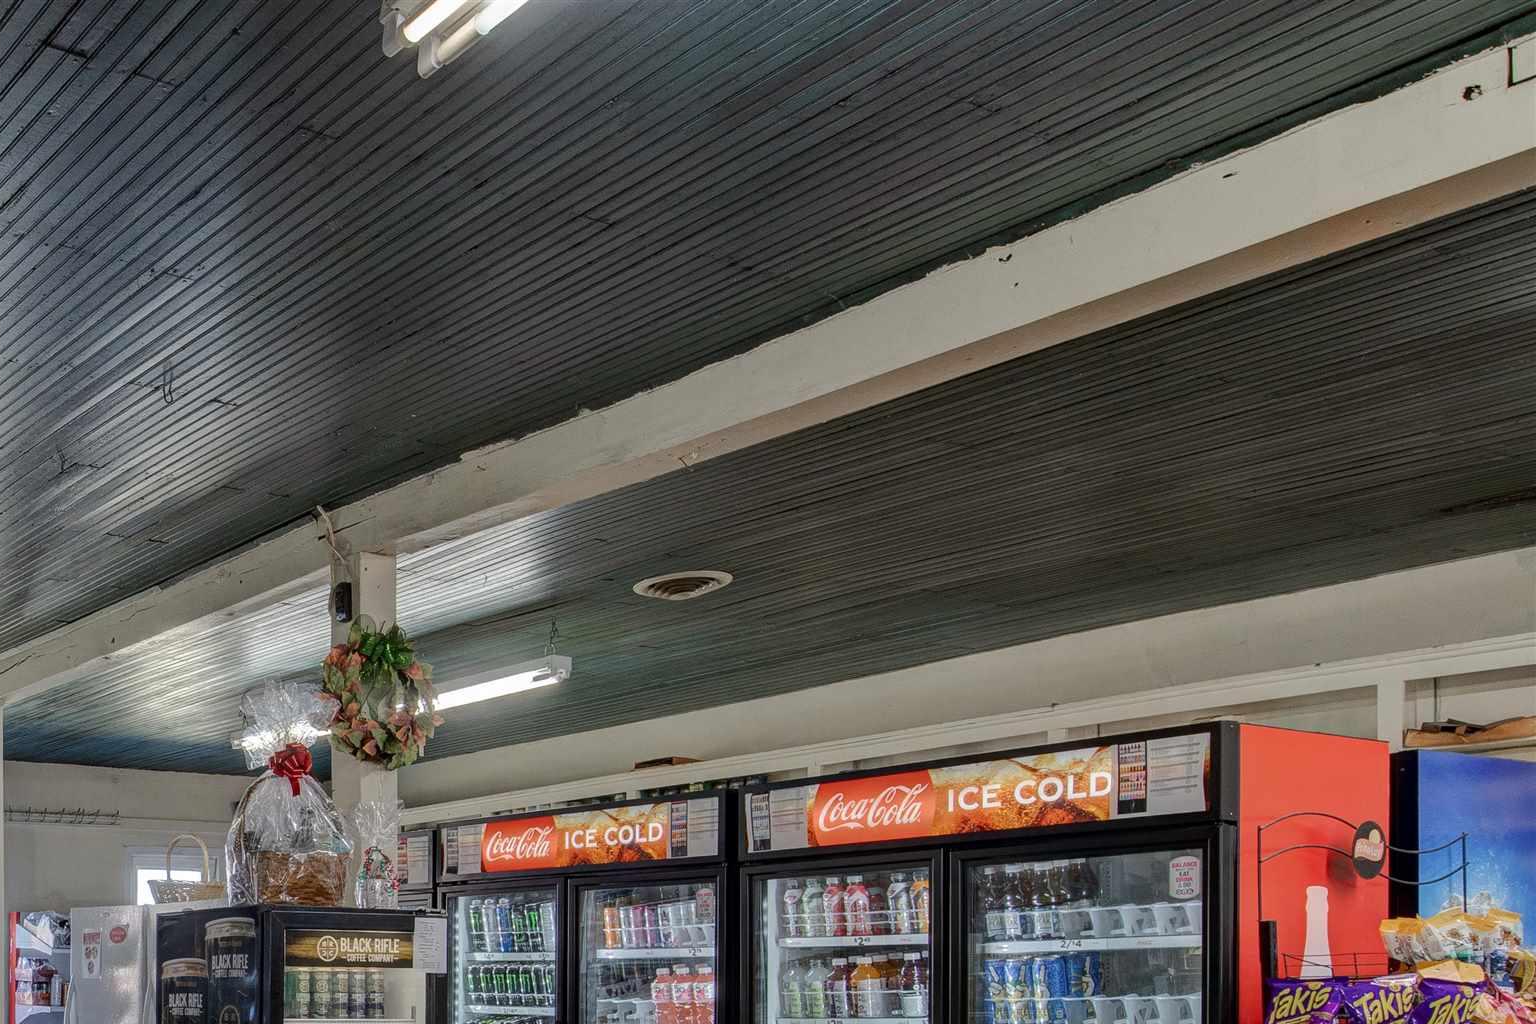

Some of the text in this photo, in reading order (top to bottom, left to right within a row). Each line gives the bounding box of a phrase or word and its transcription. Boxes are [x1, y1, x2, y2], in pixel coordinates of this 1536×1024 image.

[948, 771, 1112, 813] ICE COLD
[818, 783, 928, 832] Coca-Cola
[487, 826, 554, 862] Coca-Cola
[565, 828, 597, 849] ICE
[603, 823, 663, 846] COLD
[340, 938, 400, 953] BLACK RIFLE
[368, 954, 394, 962] COMPANY
[211, 954, 248, 969] BLACK RIFLE
[169, 993, 203, 1008] BLACK RIFLE
[1268, 982, 1332, 1024] Takis
